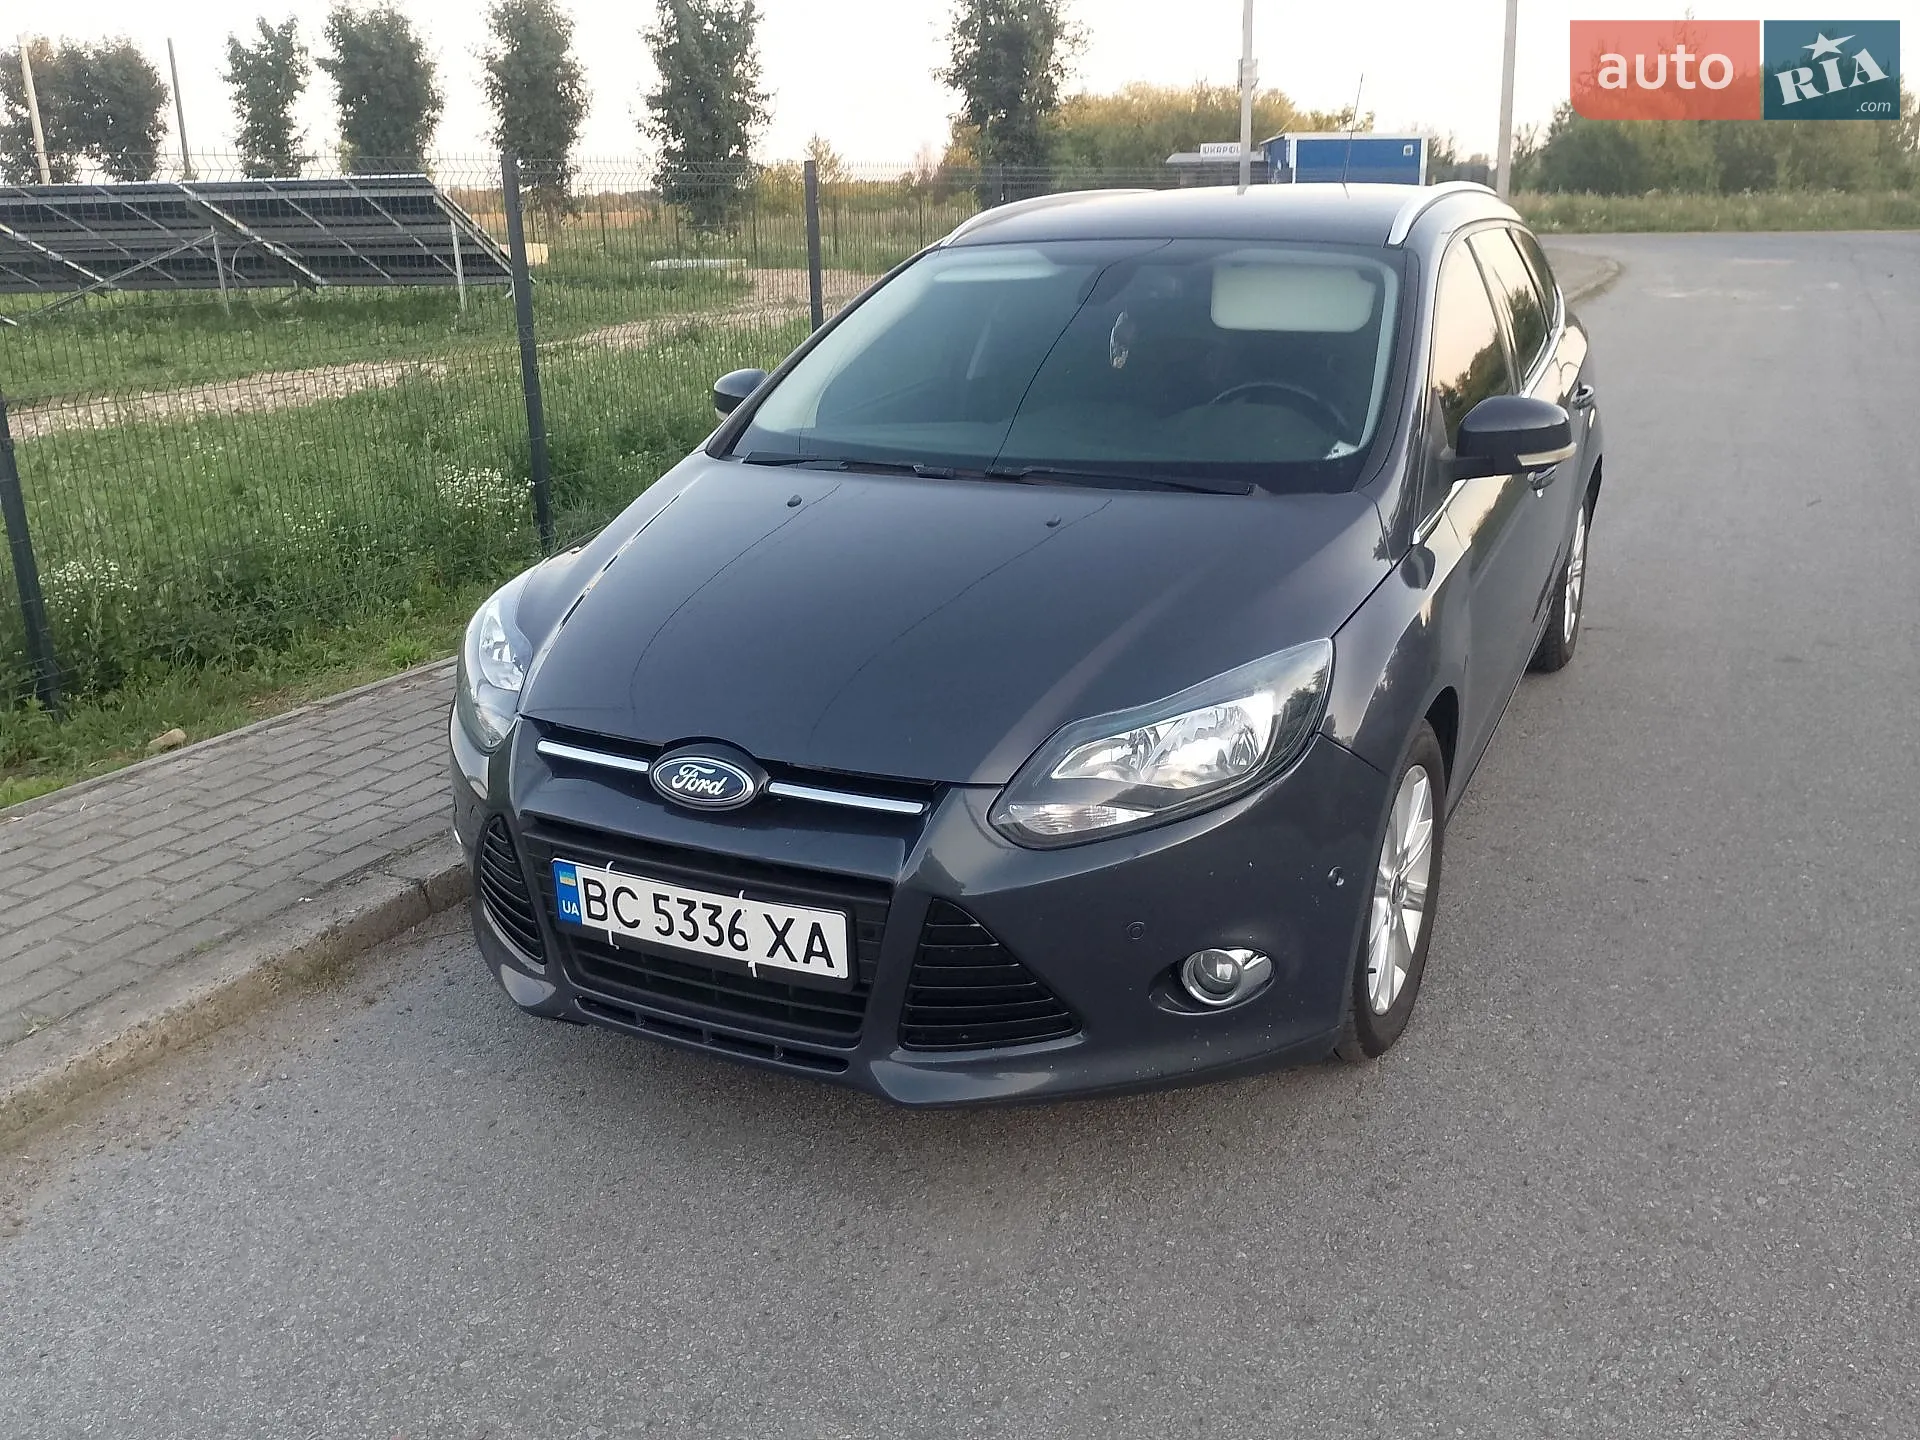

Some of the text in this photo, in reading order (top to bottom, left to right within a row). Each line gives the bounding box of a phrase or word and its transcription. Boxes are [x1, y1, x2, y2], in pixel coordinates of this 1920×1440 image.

[671, 763, 727, 796] Ford
[562, 899, 580, 917] UA
[582, 877, 835, 969] BC 5336 XA
